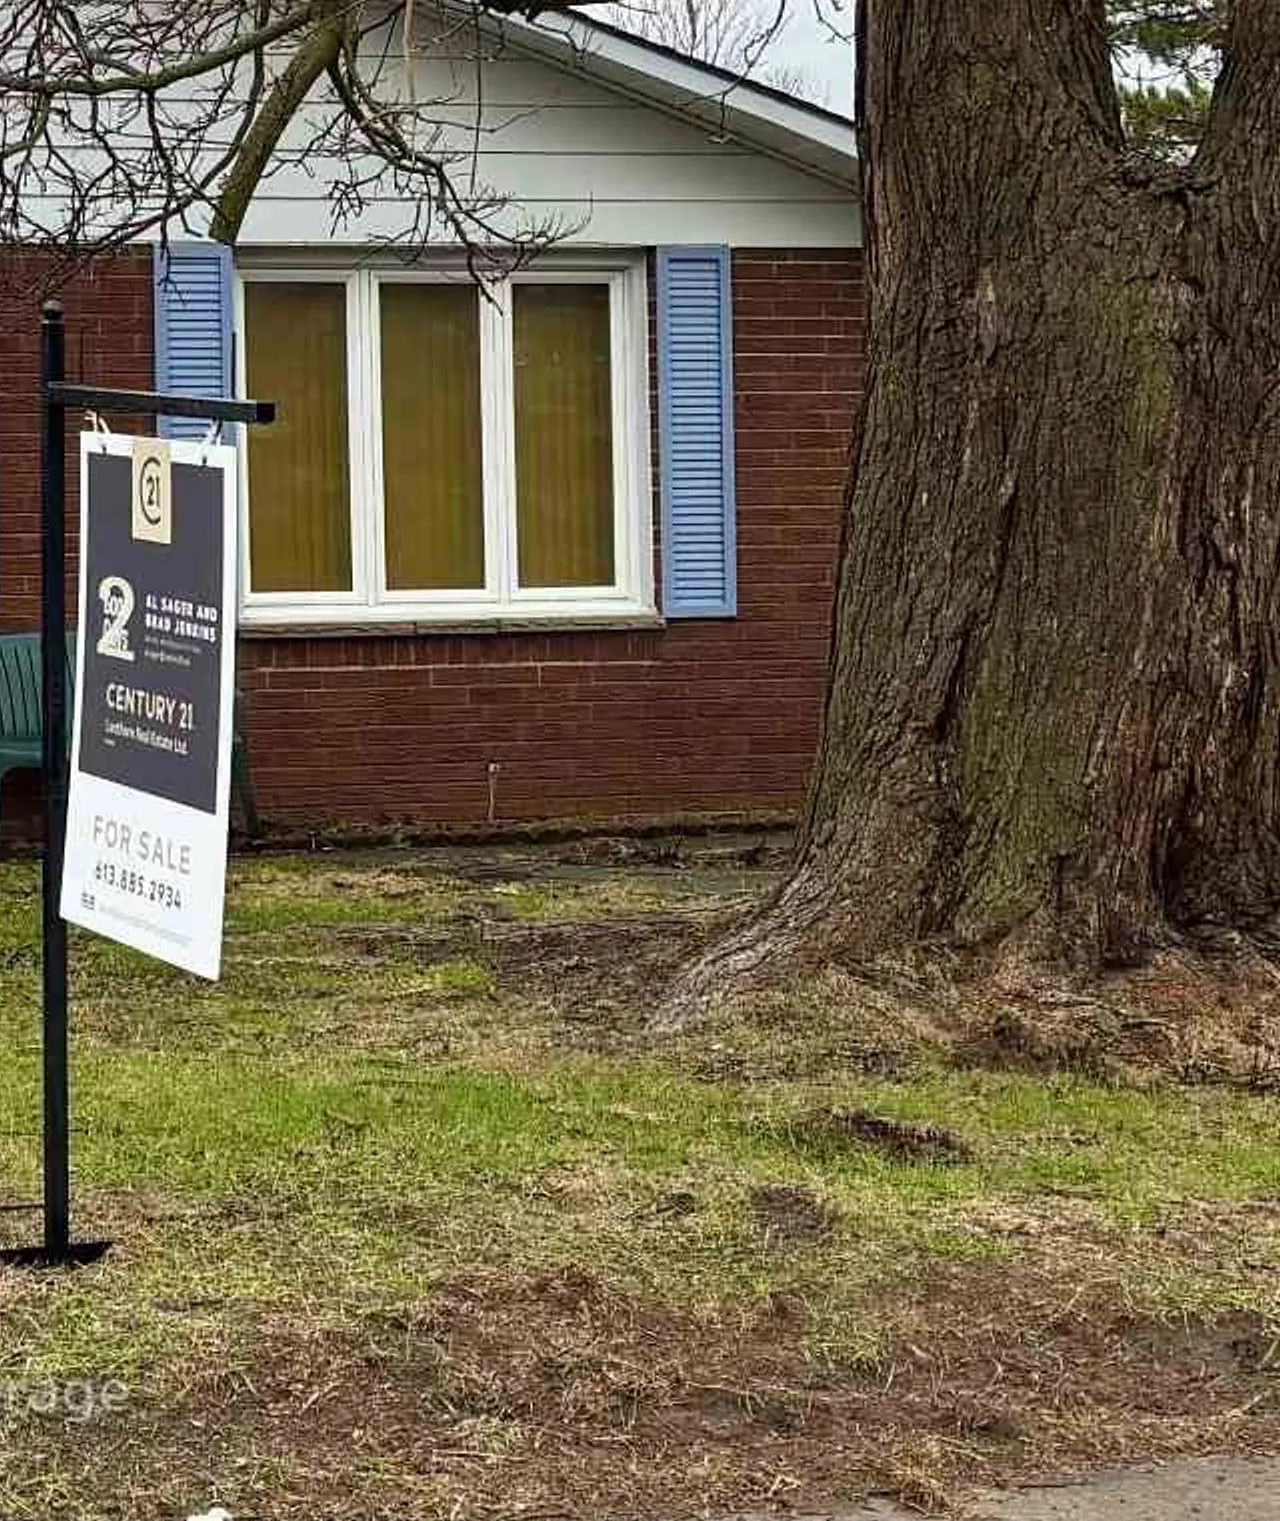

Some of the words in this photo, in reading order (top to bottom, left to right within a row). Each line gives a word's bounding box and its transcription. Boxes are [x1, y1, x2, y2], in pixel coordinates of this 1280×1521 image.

[146, 475, 160, 508] 21
[145, 593, 159, 610] AL
[195, 604, 218, 623] AND
[105, 682, 177, 726] CENTURY
[179, 702, 193, 730] 21
[93, 814, 131, 856] FOR
[138, 830, 191, 876] SALE
